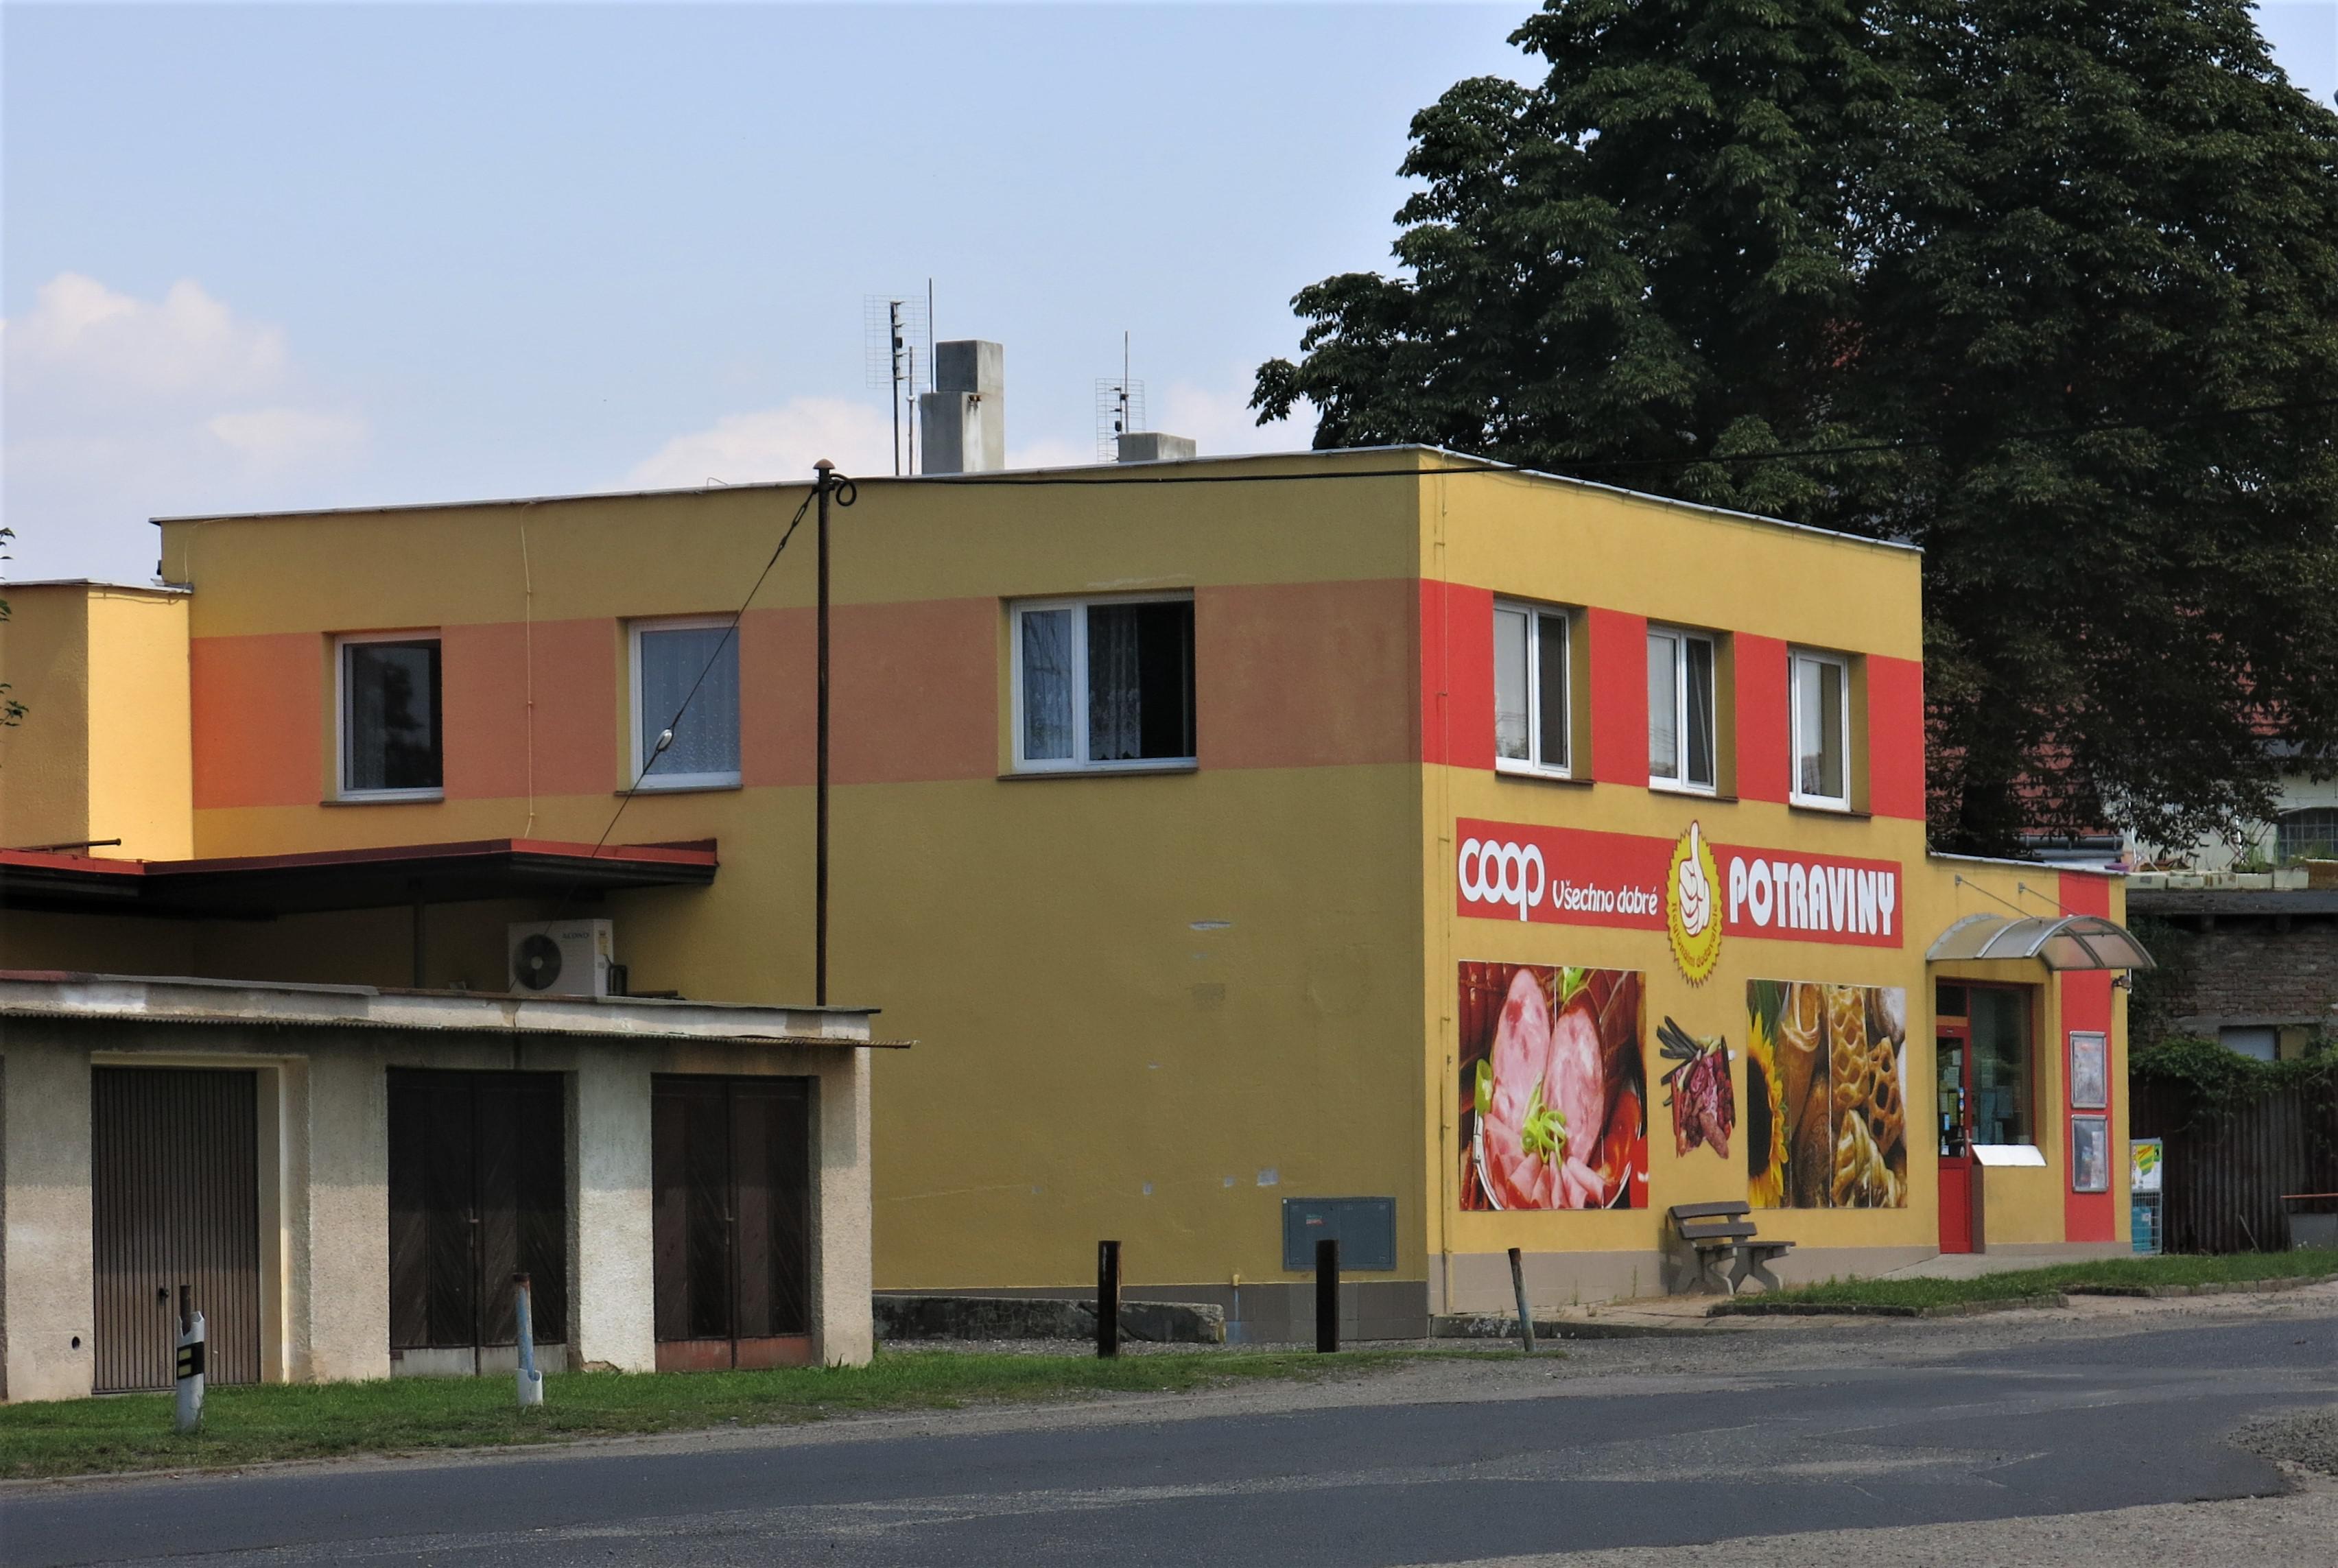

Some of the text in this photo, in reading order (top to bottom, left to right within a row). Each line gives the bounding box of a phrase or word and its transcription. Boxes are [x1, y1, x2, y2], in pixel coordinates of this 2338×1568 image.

[1552, 880, 1658, 916] Všechno dobré
[1729, 856, 1895, 936] POTRAVINY
